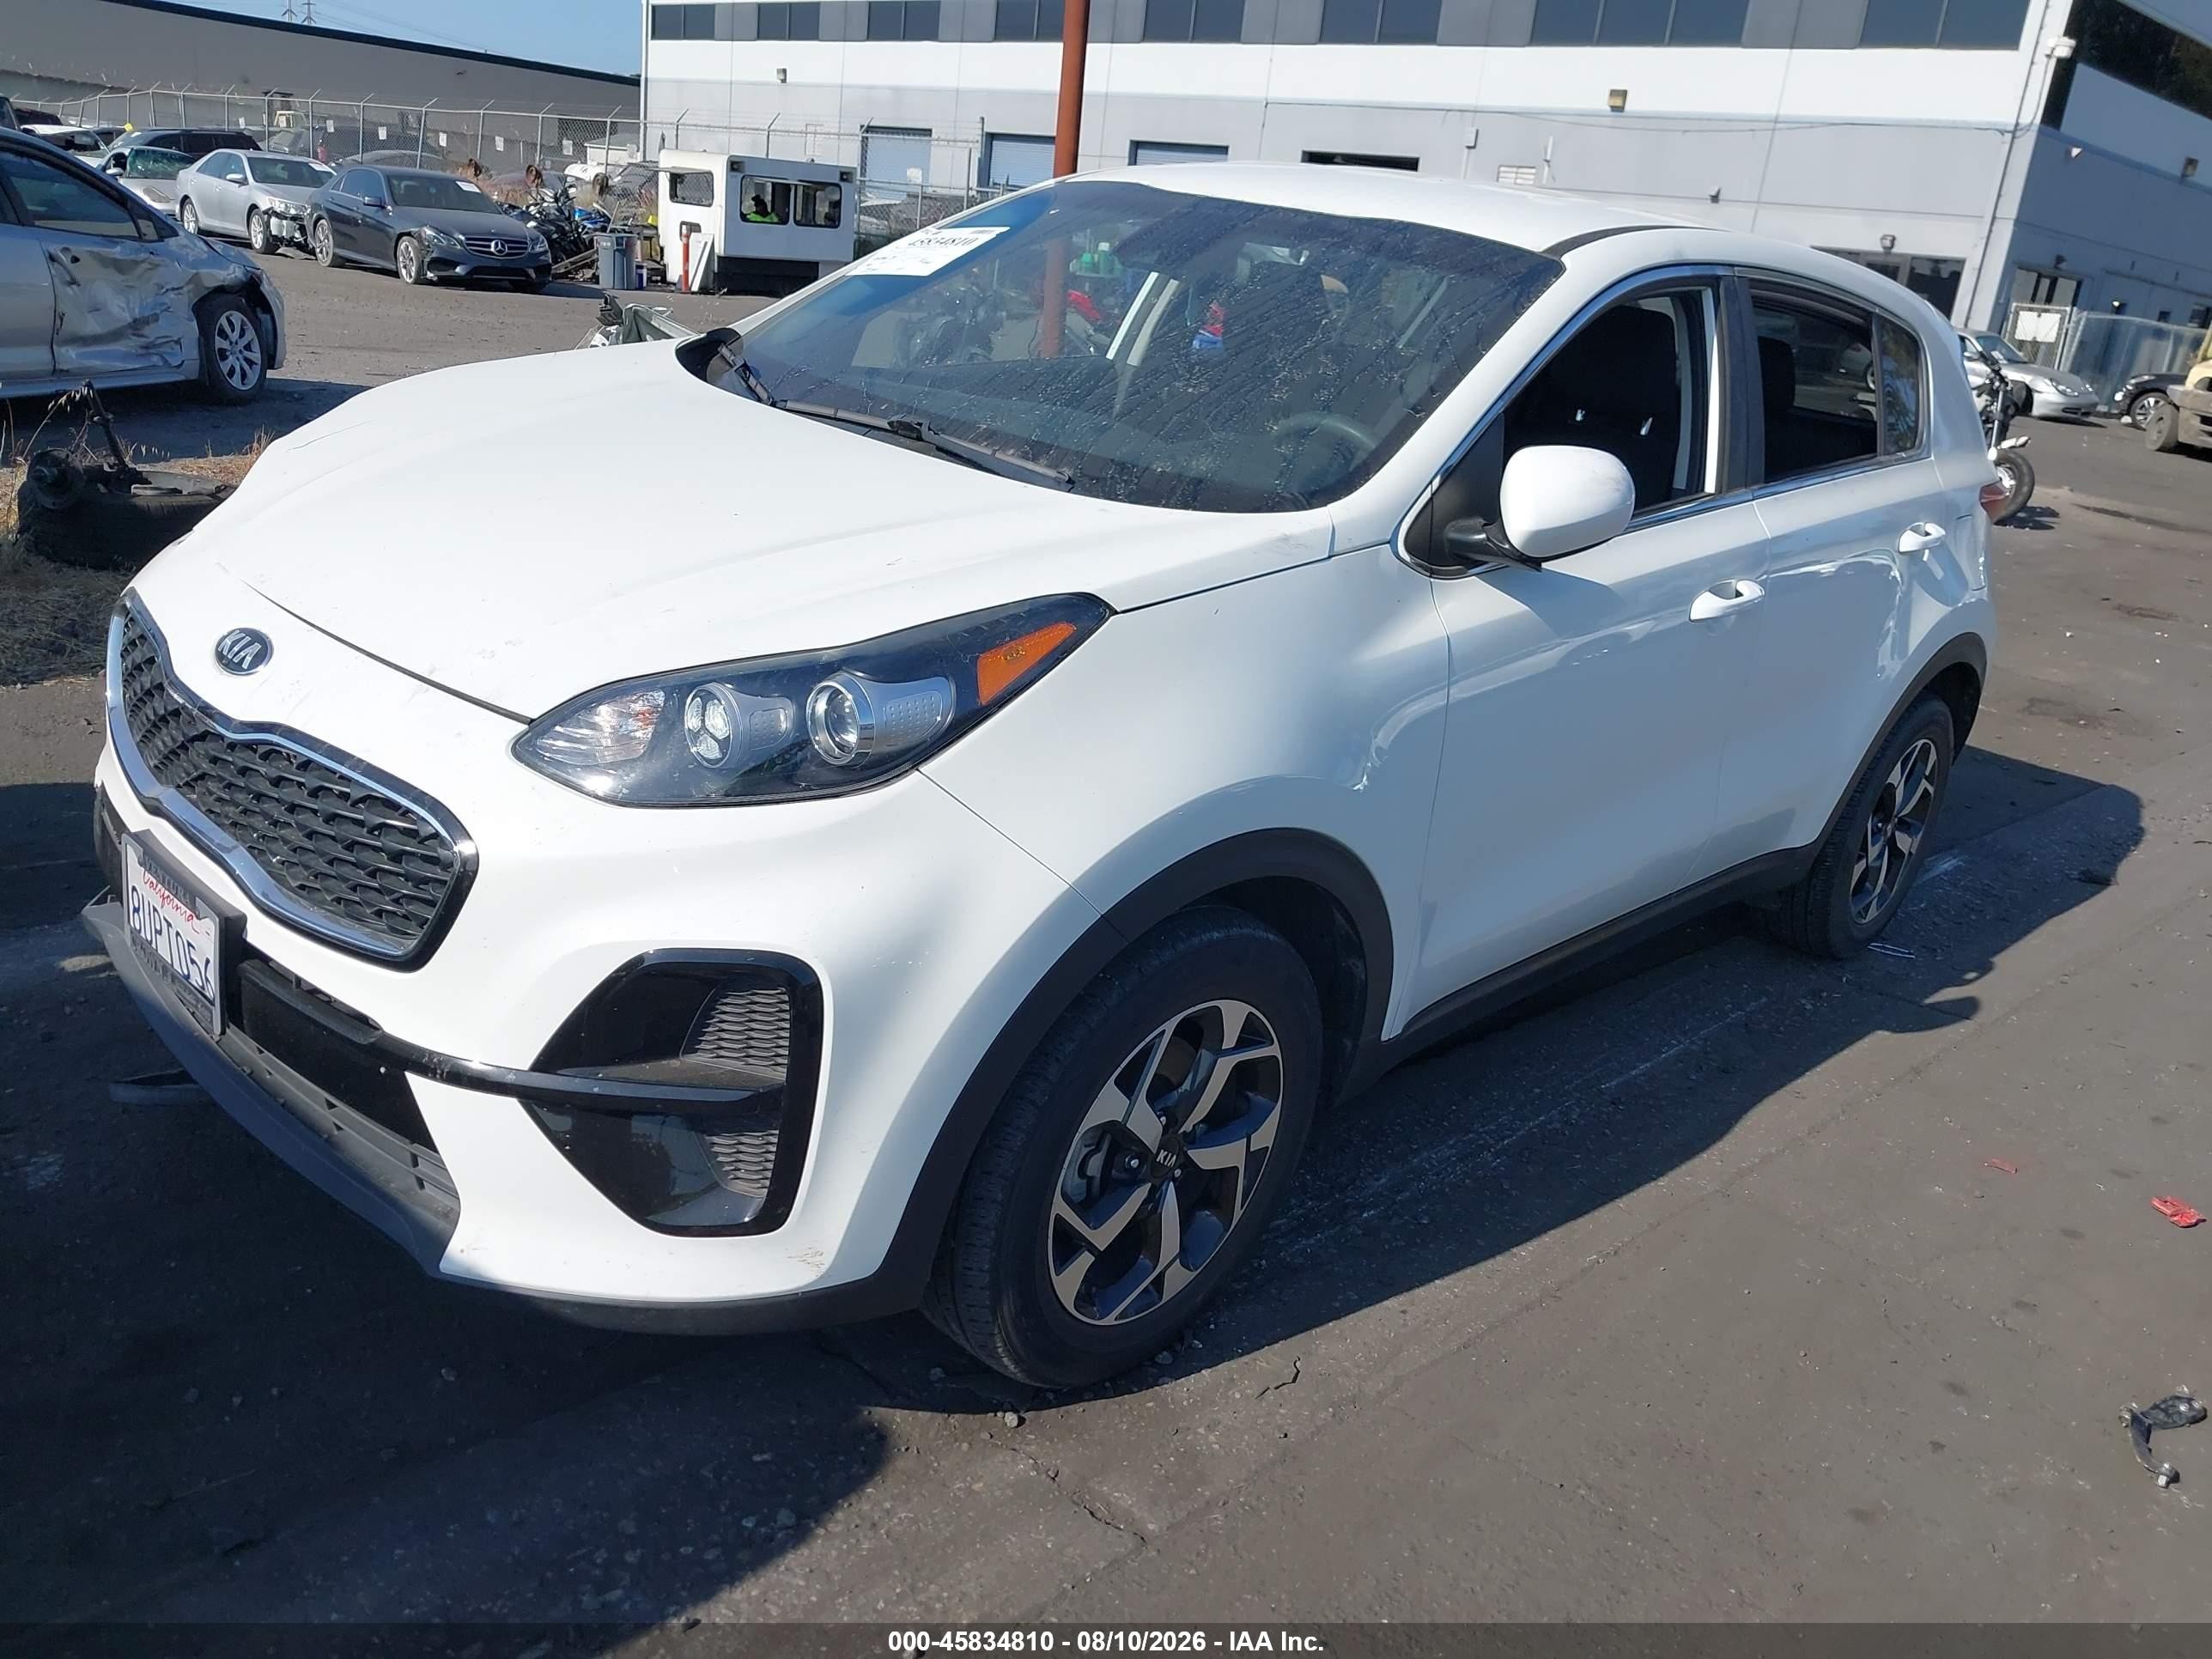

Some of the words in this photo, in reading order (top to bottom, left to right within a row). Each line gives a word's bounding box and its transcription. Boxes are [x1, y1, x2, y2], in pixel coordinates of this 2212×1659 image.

[217, 629, 261, 669] KIA
[131, 884, 215, 1000] 8UPT056
[1156, 1149, 1176, 1168] KIA
